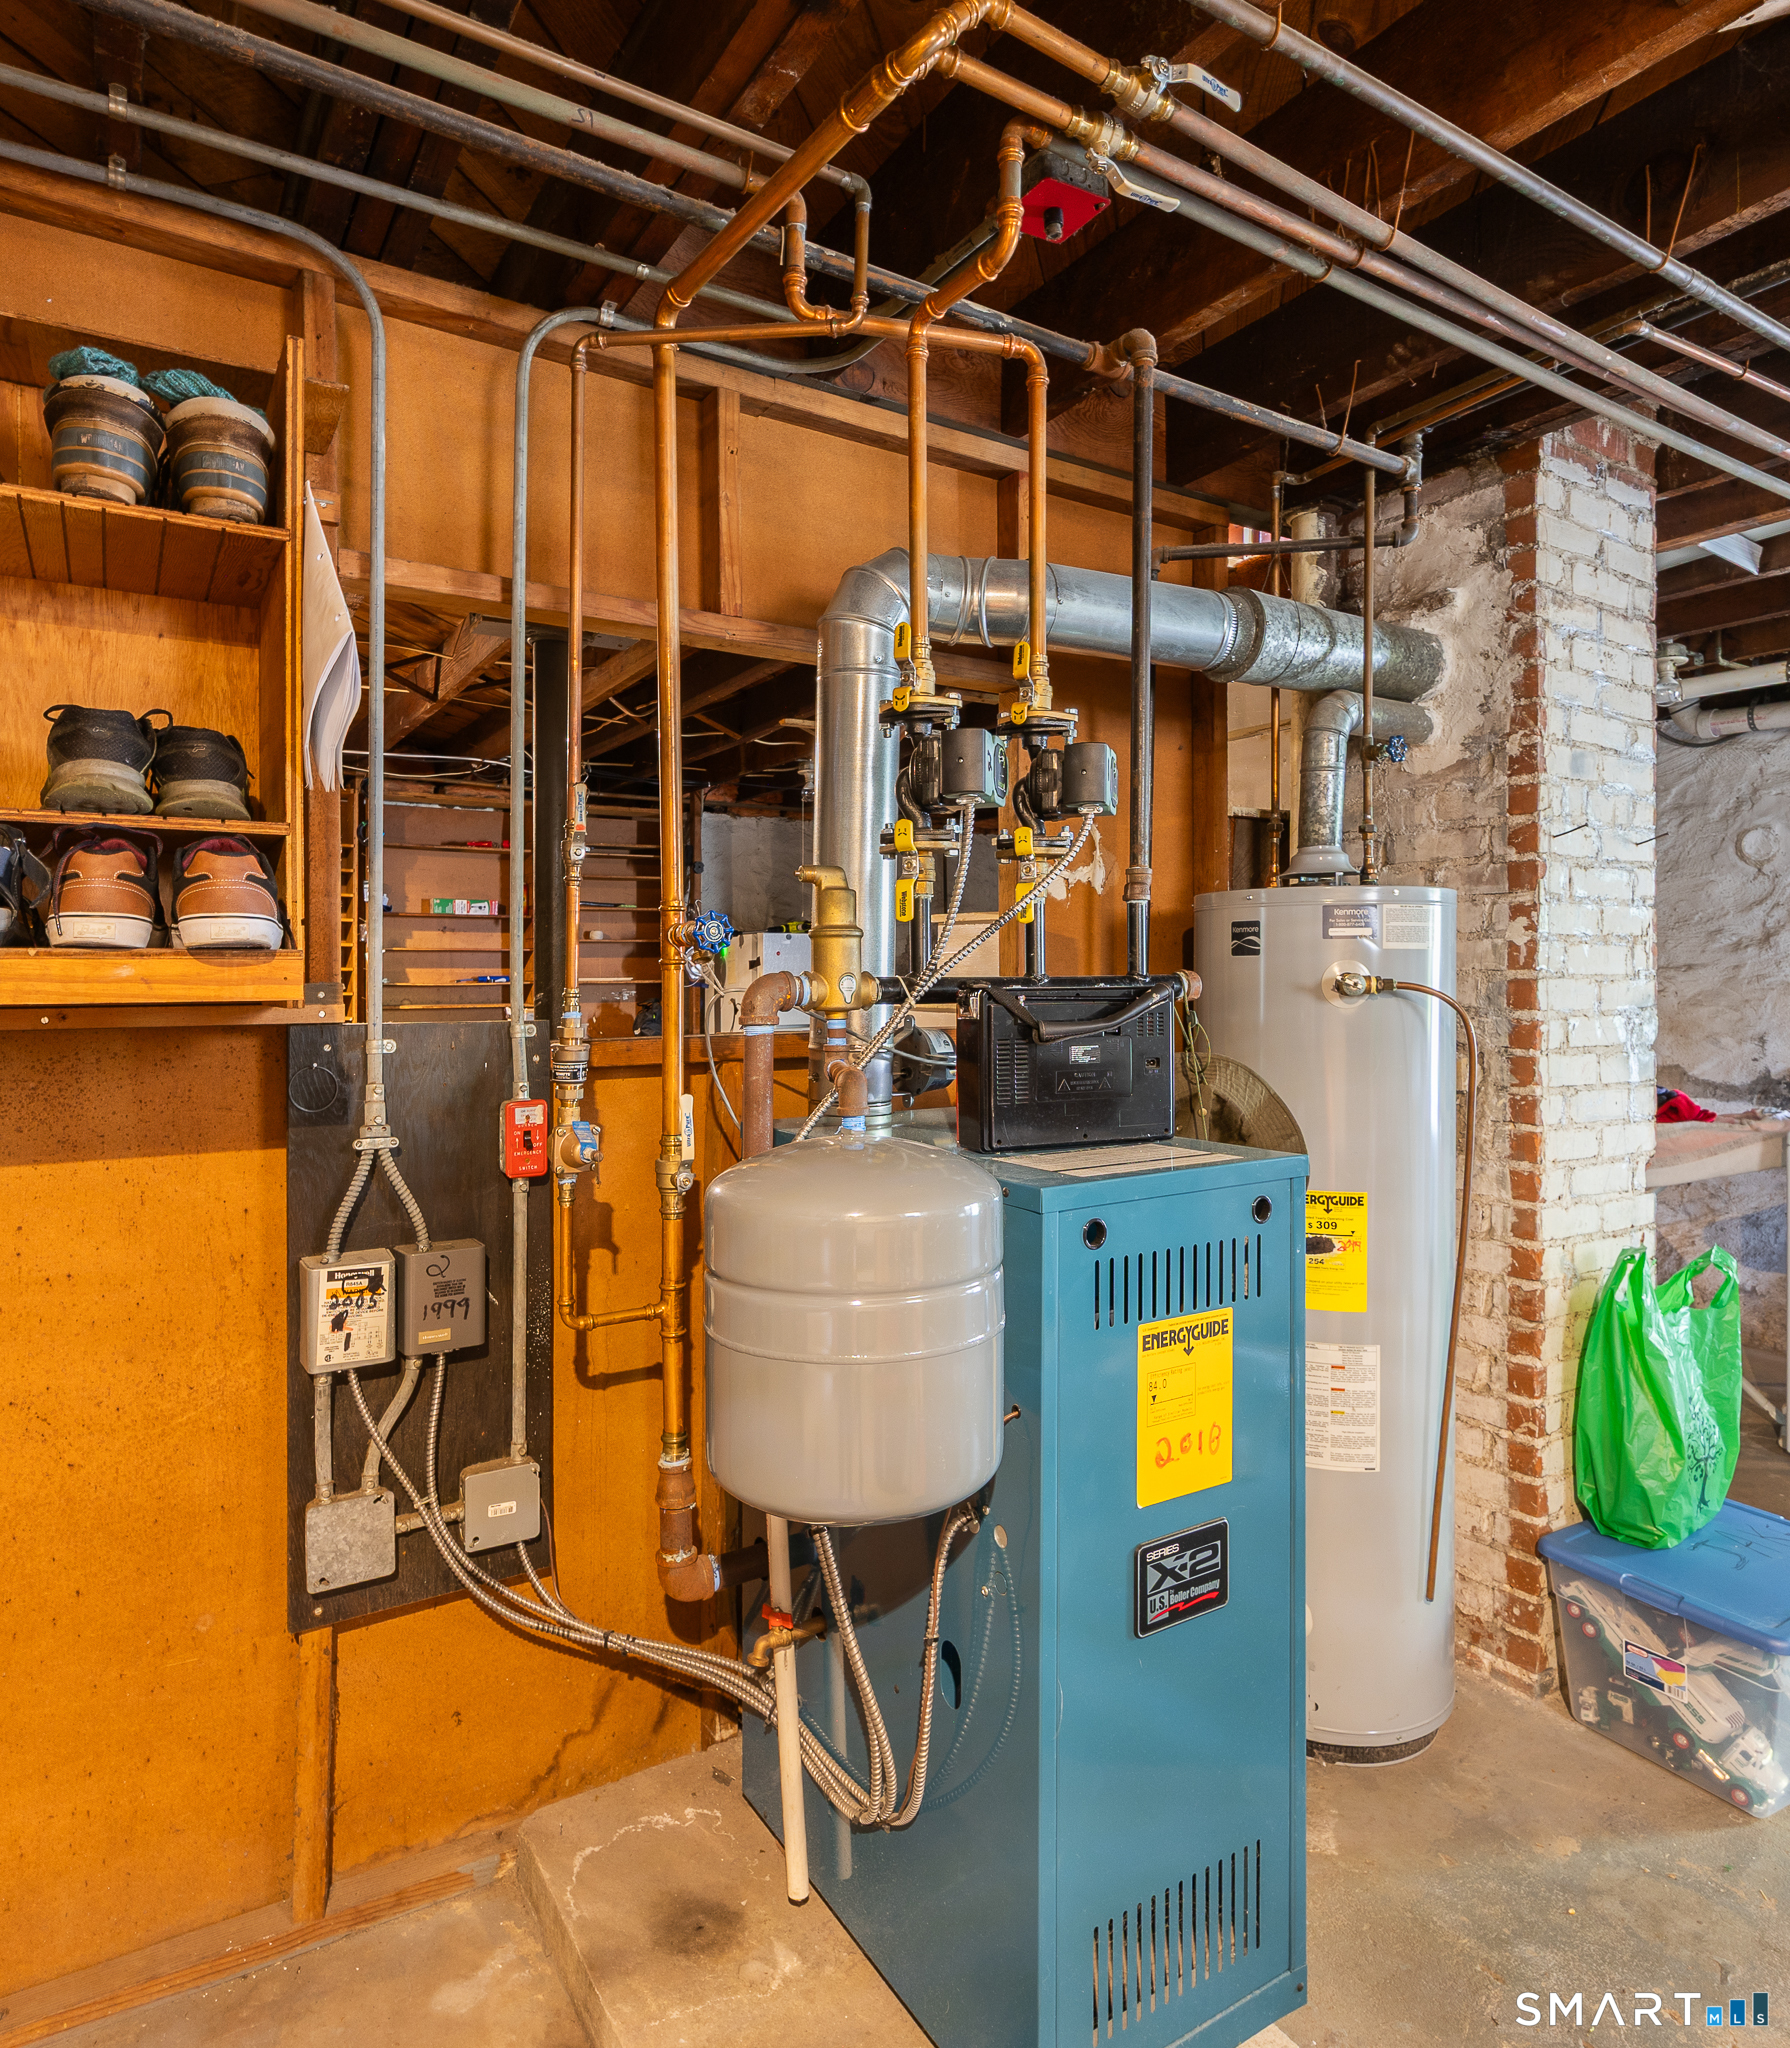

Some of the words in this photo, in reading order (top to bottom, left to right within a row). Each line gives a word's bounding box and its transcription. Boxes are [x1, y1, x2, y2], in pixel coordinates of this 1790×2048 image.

[1334, 908, 1369, 916] Kenmore
[1232, 926, 1260, 934] Kenmore
[513, 1149, 542, 1157] EMERGENCY
[1306, 1194, 1364, 1207] ERGYGUIDE
[1316, 1220, 1338, 1230] 309
[426, 1255, 451, 1278] 2
[1308, 1257, 1325, 1265] 254
[422, 1297, 470, 1321] 1999
[1142, 1319, 1229, 1354] ENERGYGUIDE
[1149, 1379, 1167, 1392] 84.0
[1155, 1421, 1221, 1469] 2018
[1146, 1543, 1180, 1562] SERIES
[1149, 1595, 1168, 1614] U.S.
[1169, 1589, 1190, 1605] Boiler
[1190, 1579, 1220, 1598] Company
[1683, 1702, 1706, 1725] ESS
